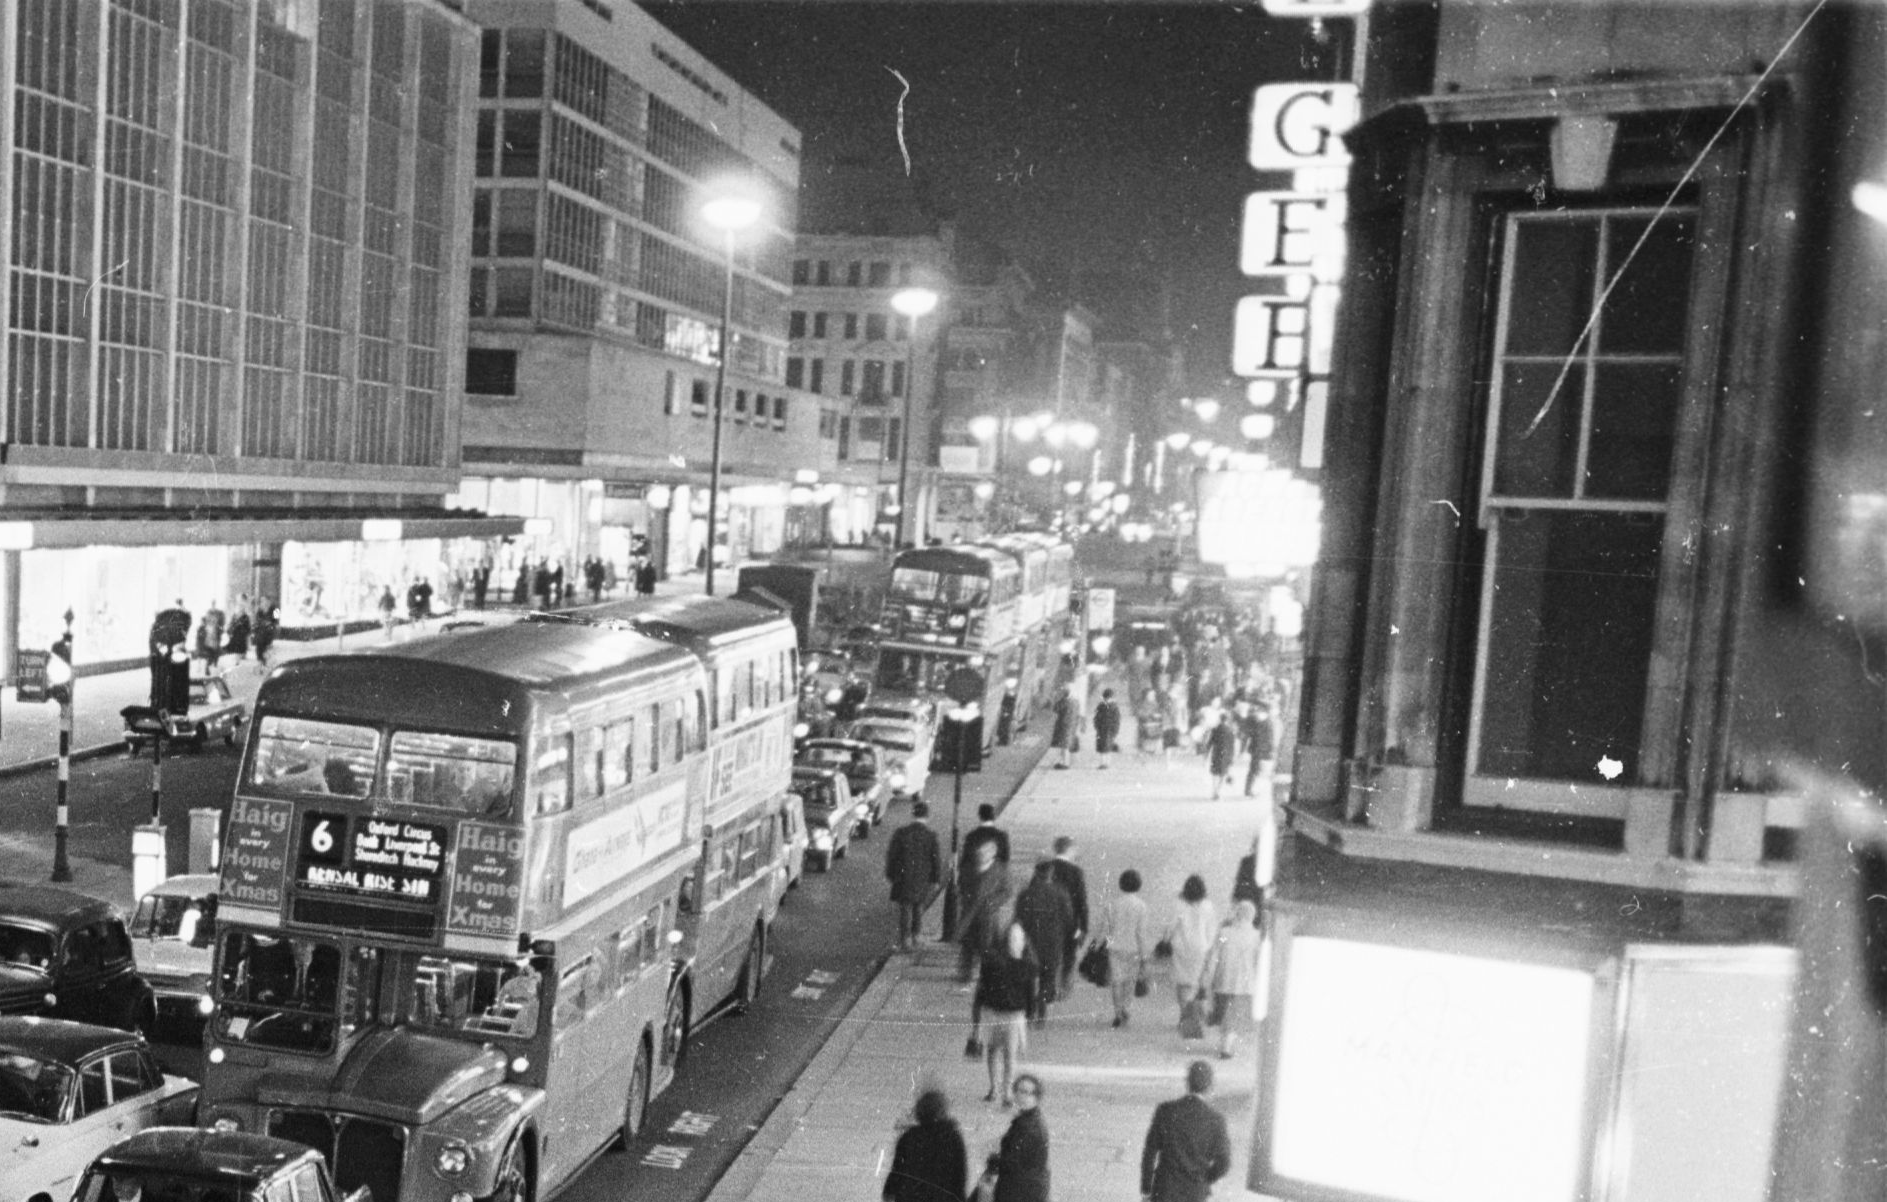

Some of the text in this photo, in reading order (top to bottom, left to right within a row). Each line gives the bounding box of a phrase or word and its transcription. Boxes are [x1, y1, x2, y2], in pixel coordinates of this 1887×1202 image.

[19, 656, 44, 666] TURN
[19, 667, 44, 677] LEFT
[231, 801, 289, 833] Haig
[250, 828, 262, 837] in
[311, 820, 333, 853] 6
[368, 821, 432, 840] Oxford Circus
[239, 838, 271, 849] every
[459, 826, 524, 860] Haig
[223, 847, 282, 871] Home
[485, 854, 496, 864] in
[243, 870, 259, 882] for
[472, 864, 507, 877] every
[220, 877, 279, 901] Xmas
[363, 873, 395, 891] RISE
[455, 873, 520, 899] Home
[477, 899, 493, 909] for
[451, 905, 516, 930] Xmas
[1343, 1032, 1525, 1088] MANFIELD
